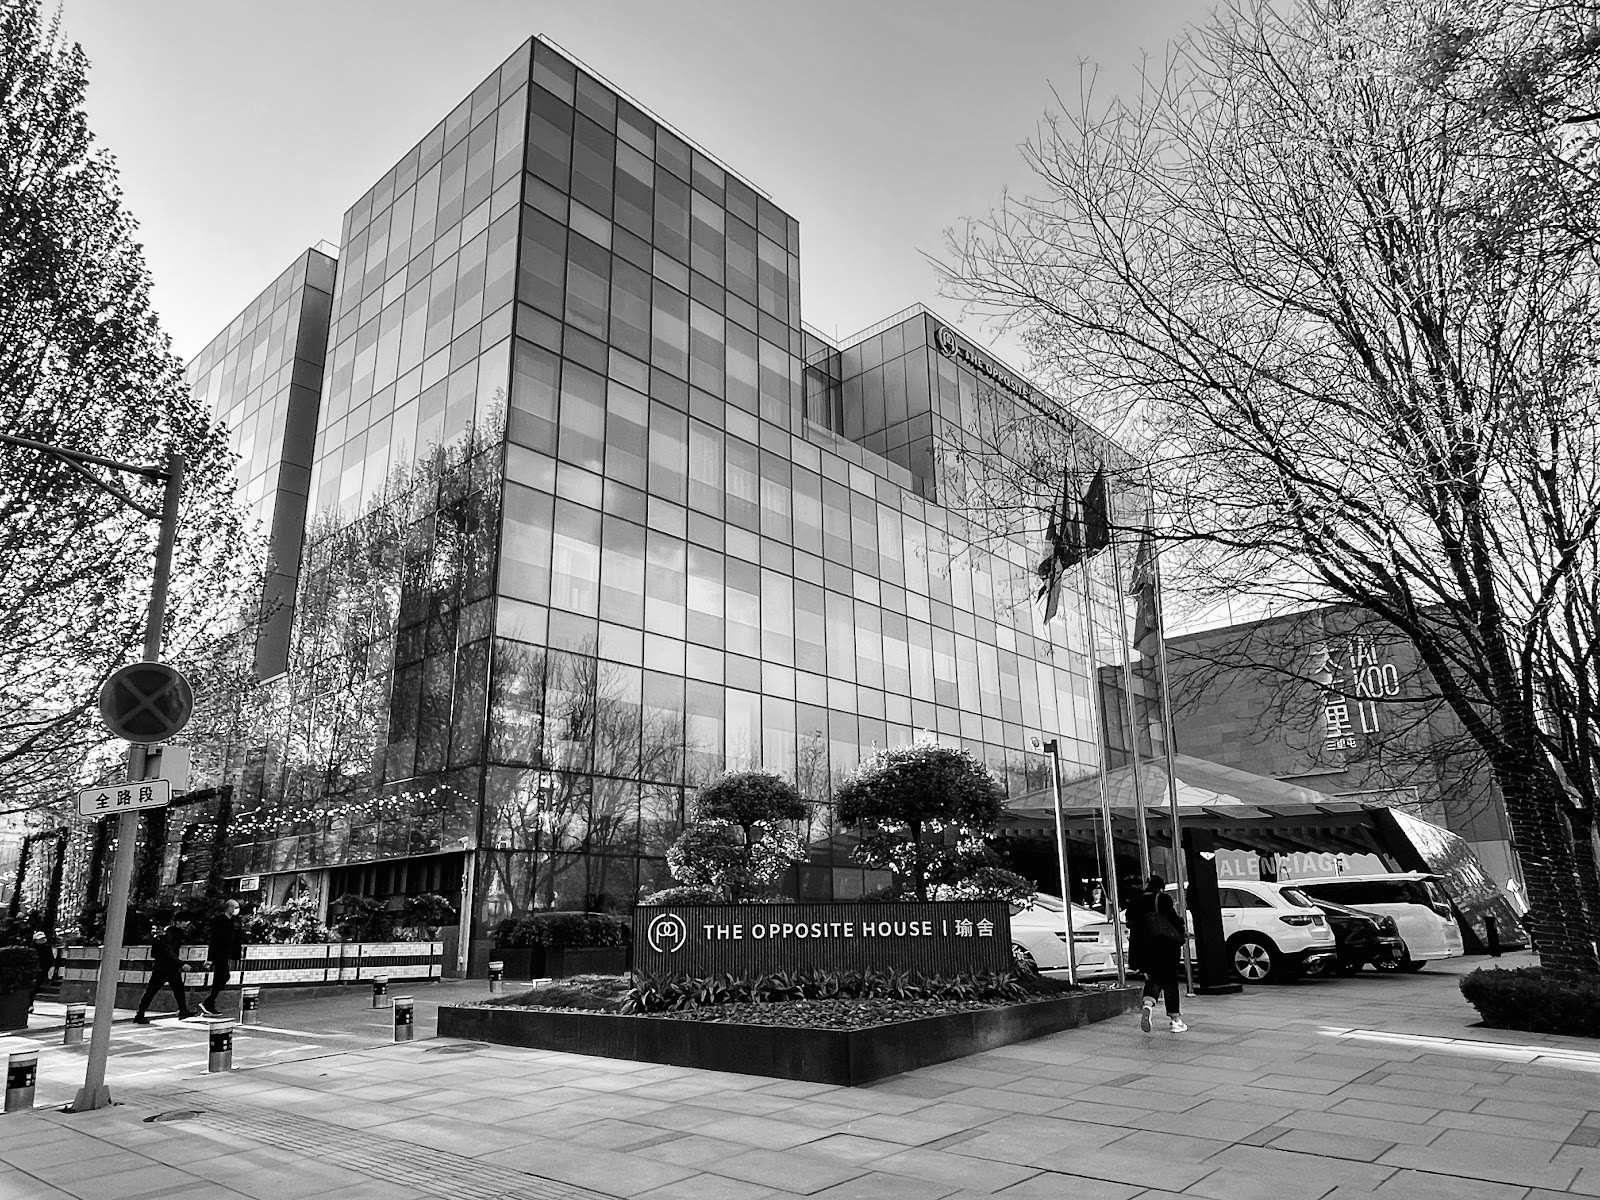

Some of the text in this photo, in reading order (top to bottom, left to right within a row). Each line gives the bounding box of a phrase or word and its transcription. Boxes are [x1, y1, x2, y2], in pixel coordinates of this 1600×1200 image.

[986, 363, 1030, 400] OPPOSITE
[1352, 664, 1400, 698] KOO
[1358, 700, 1380, 733] LI
[95, 786, 154, 809] 全路段
[1219, 854, 1351, 876] ALENCIAGA
[703, 920, 933, 940] THE OPPOSITE HOUSE
[954, 917, 994, 938] 瑜舍
